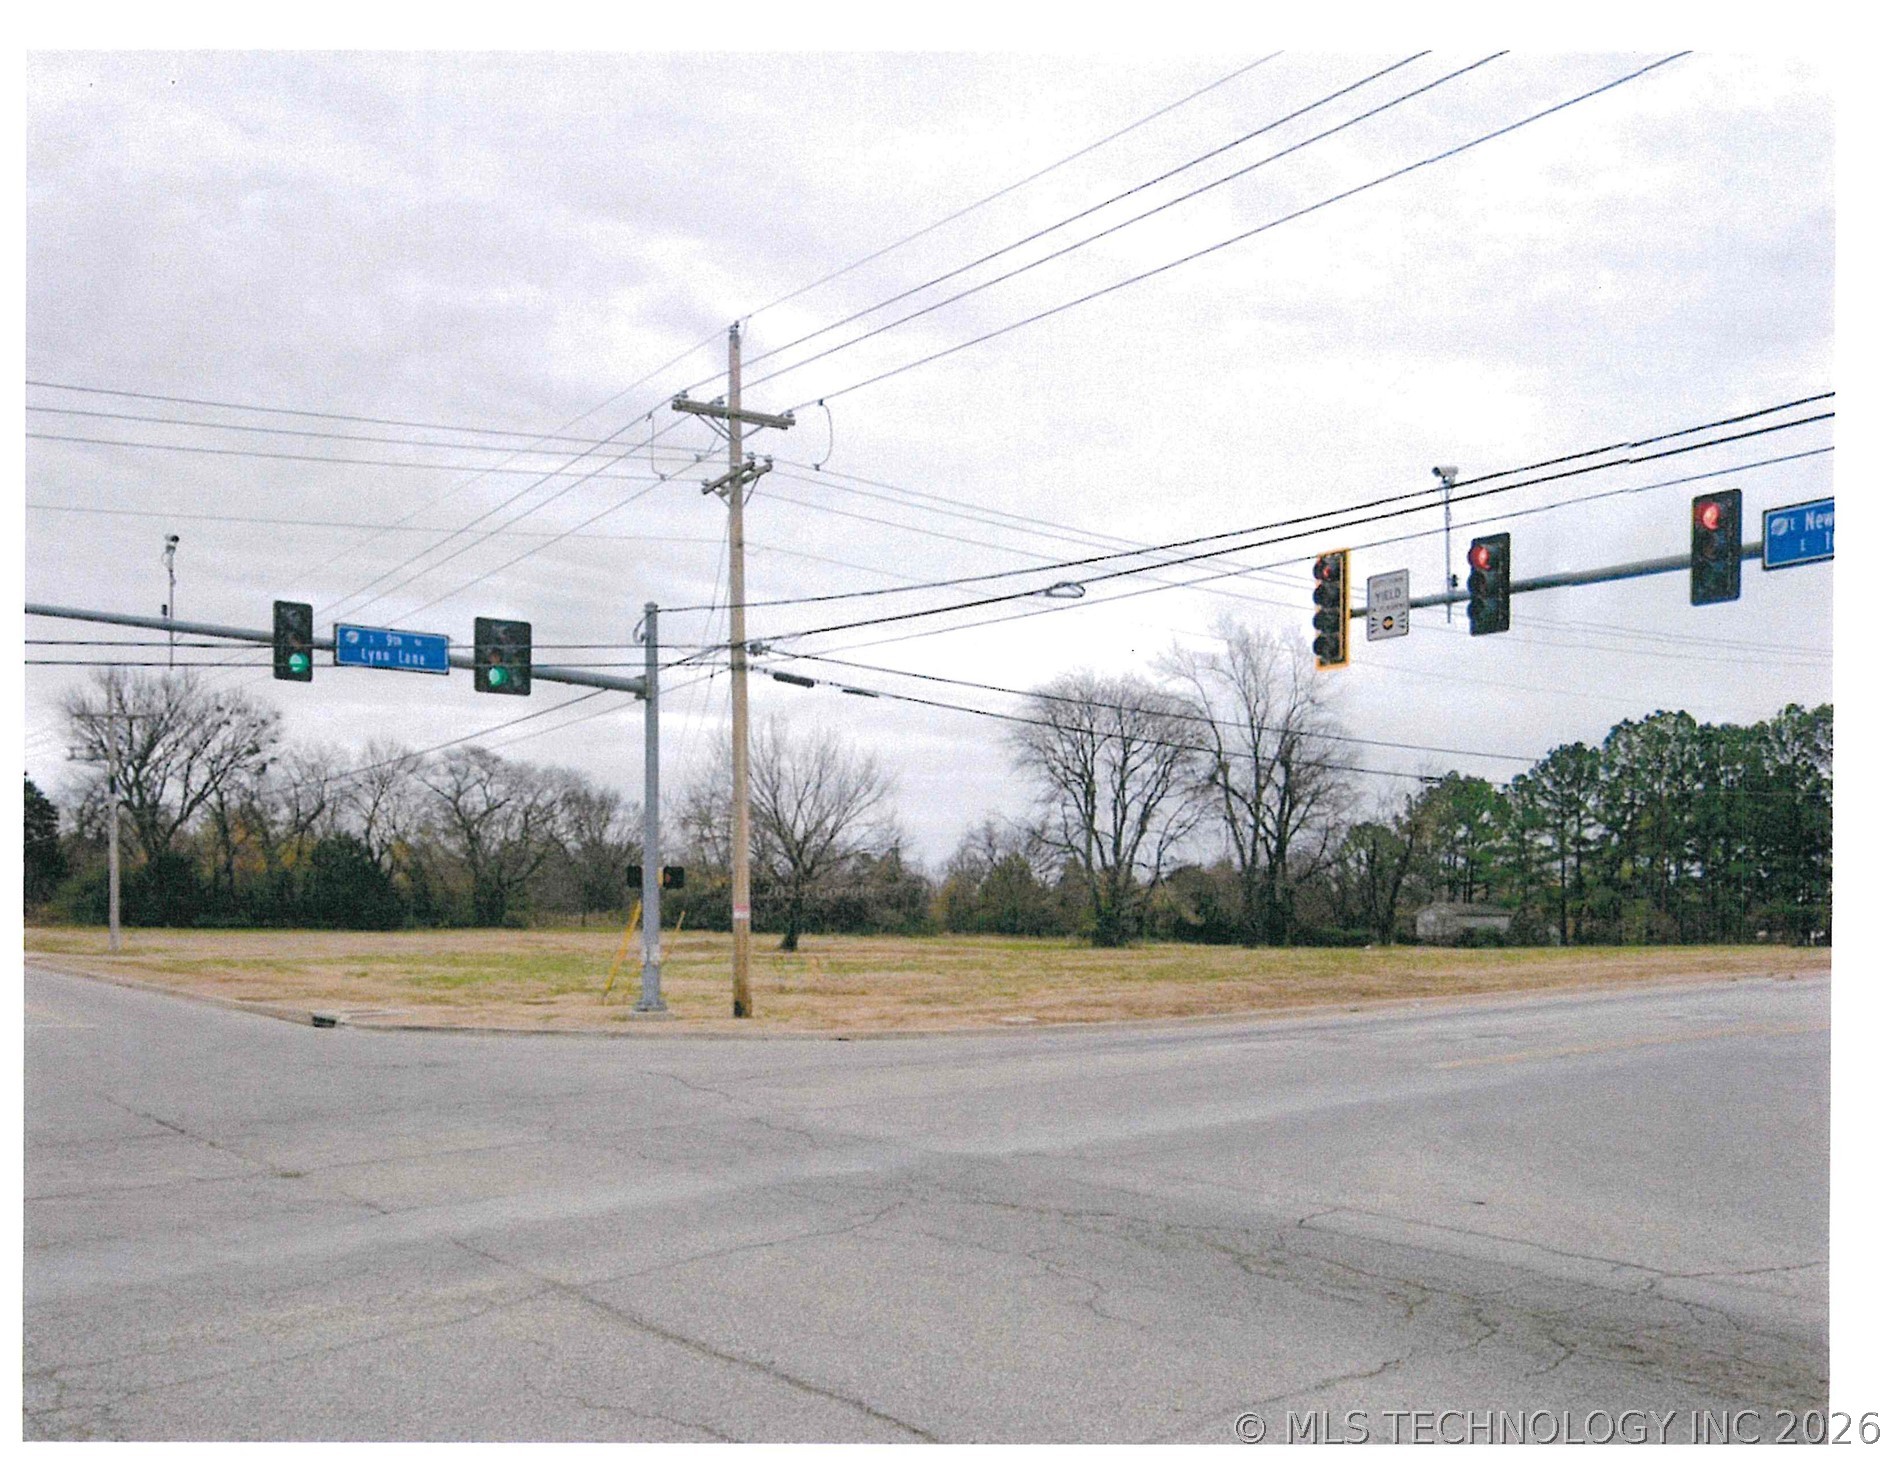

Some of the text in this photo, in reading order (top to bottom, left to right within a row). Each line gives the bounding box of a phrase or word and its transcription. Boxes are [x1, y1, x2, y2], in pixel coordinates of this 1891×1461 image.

[1375, 587, 1402, 603] YIELD
[361, 648, 425, 665] Lynn Lane
